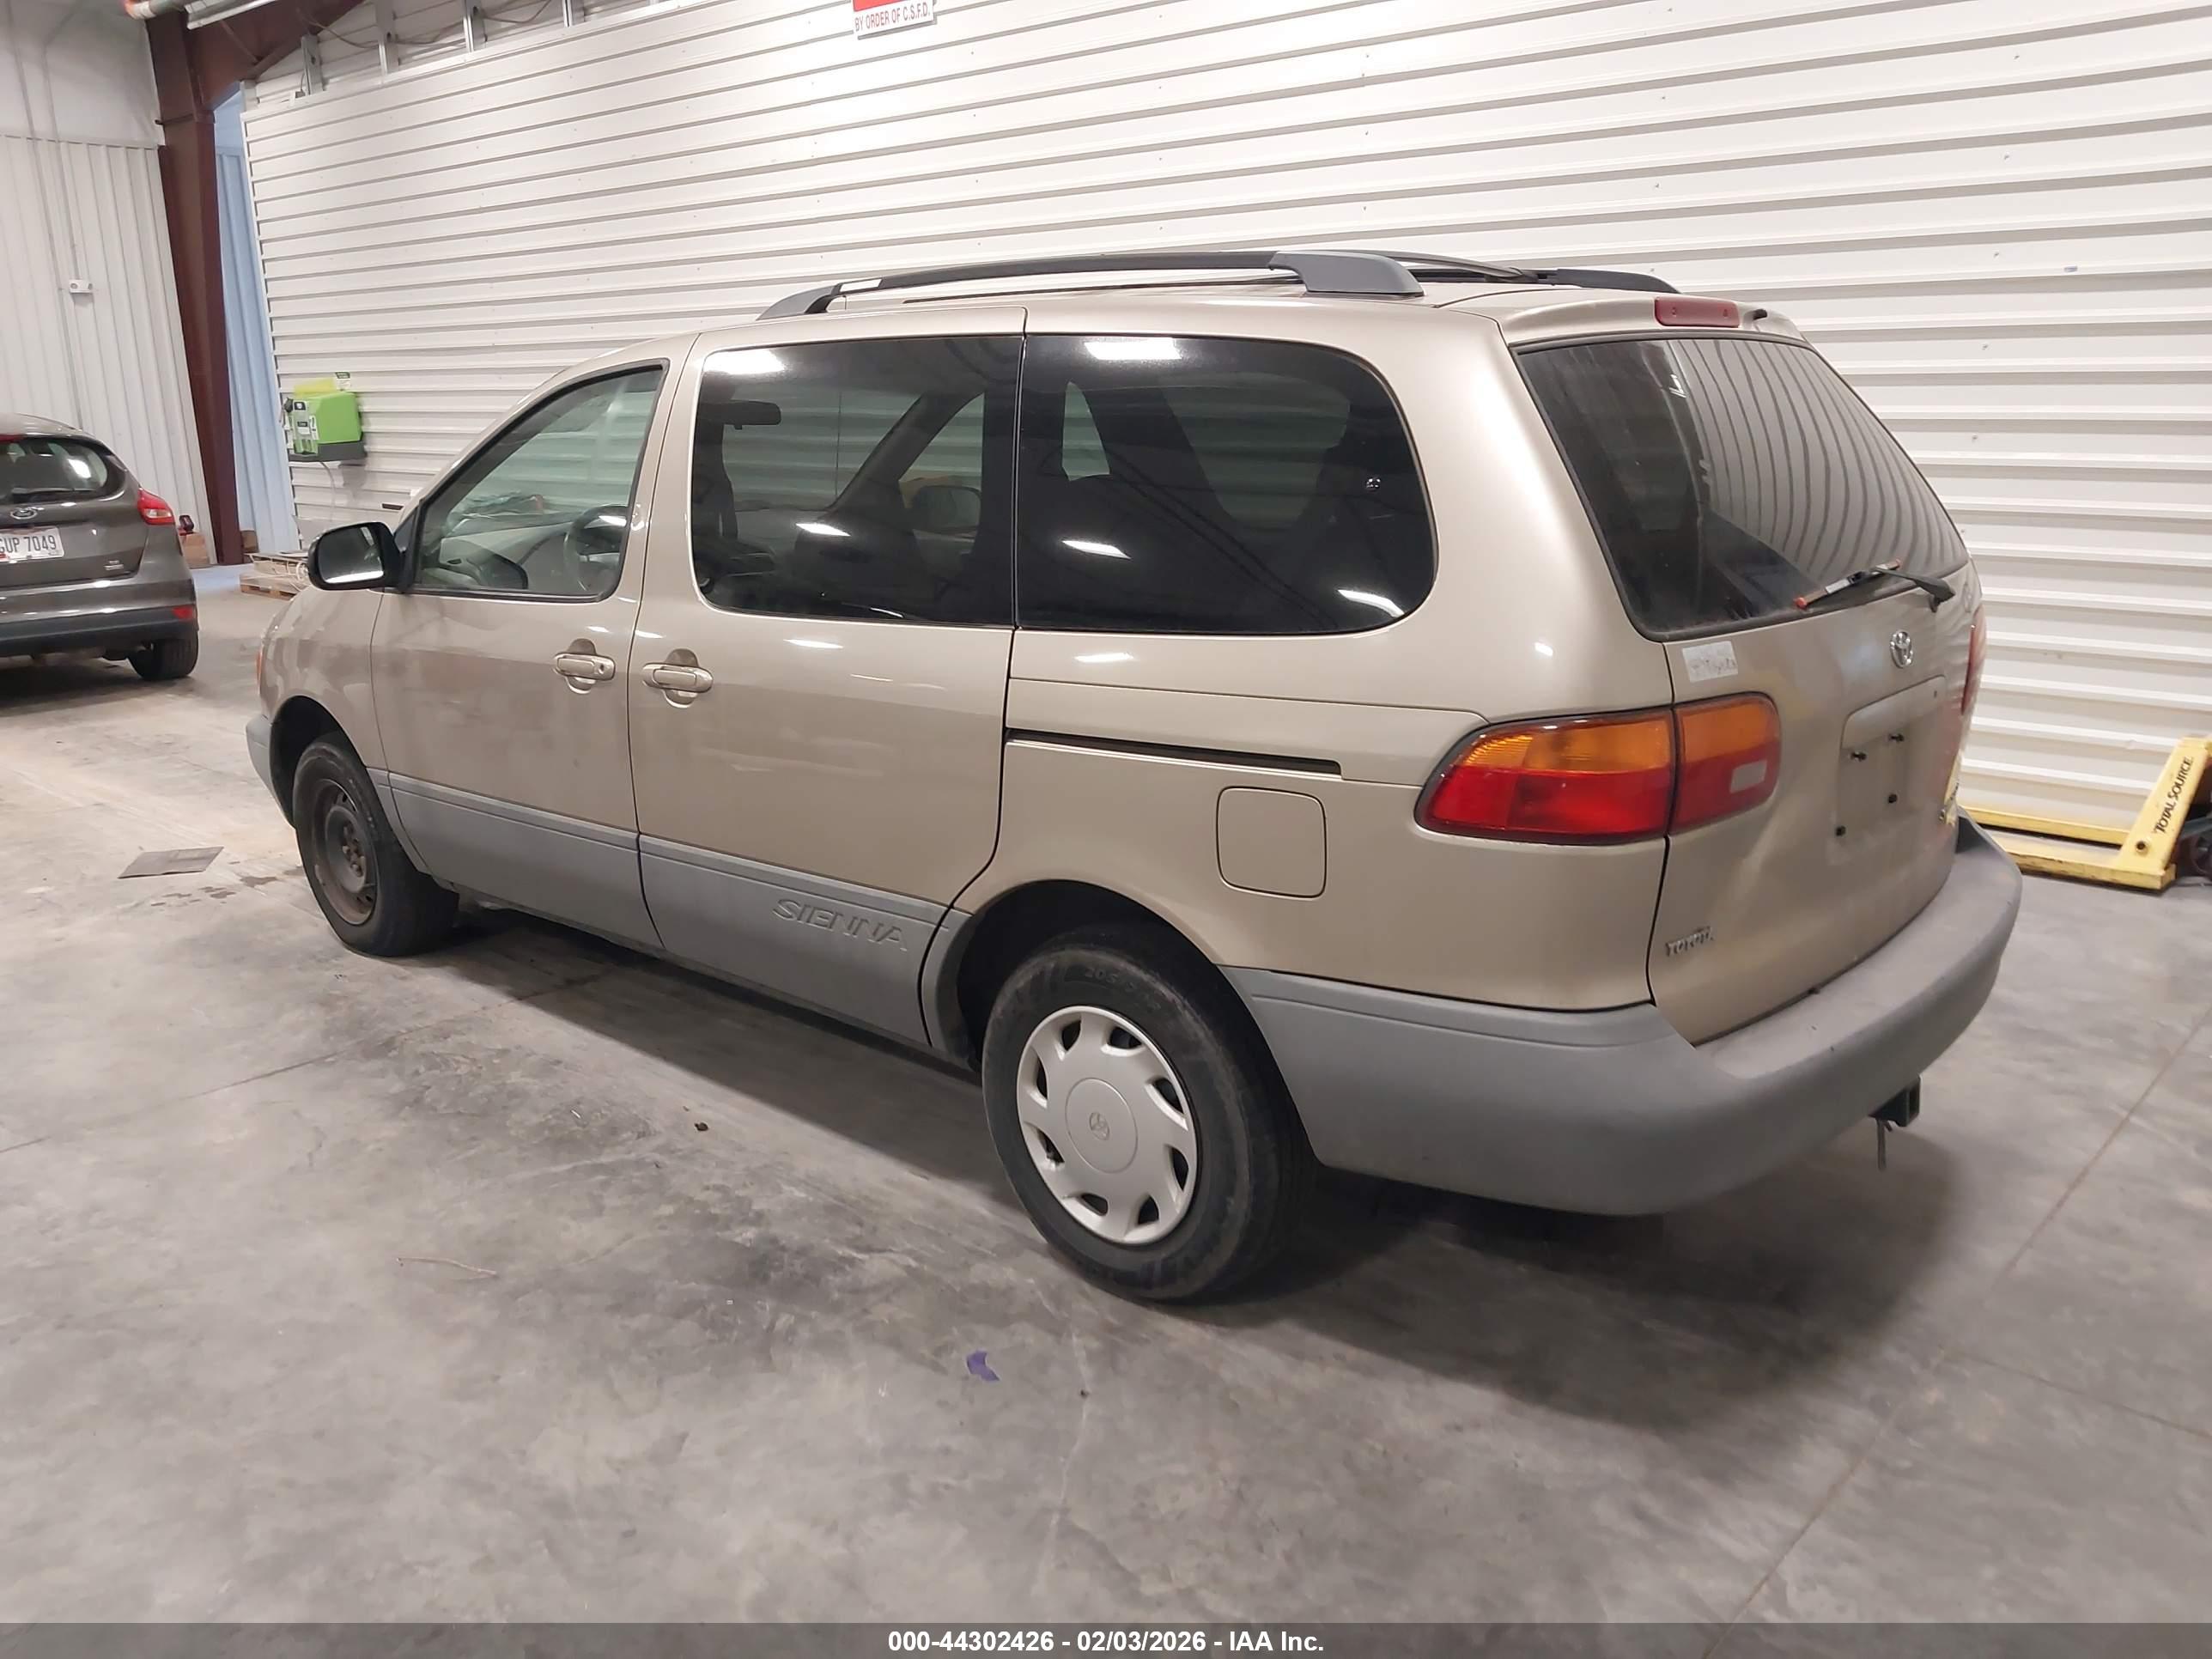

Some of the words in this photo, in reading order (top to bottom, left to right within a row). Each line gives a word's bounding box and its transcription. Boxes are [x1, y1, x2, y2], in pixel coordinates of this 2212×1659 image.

[854, 15, 864, 32] BY
[866, 10, 890, 29] ORDER
[892, 7, 901, 24] OF
[902, 2, 932, 21] C.S.F.D.
[23, 534, 57, 552] 7049
[2153, 799, 2176, 835] TOTAL
[2167, 756, 2194, 802] SOURCE
[773, 898, 908, 951] SIENNA
